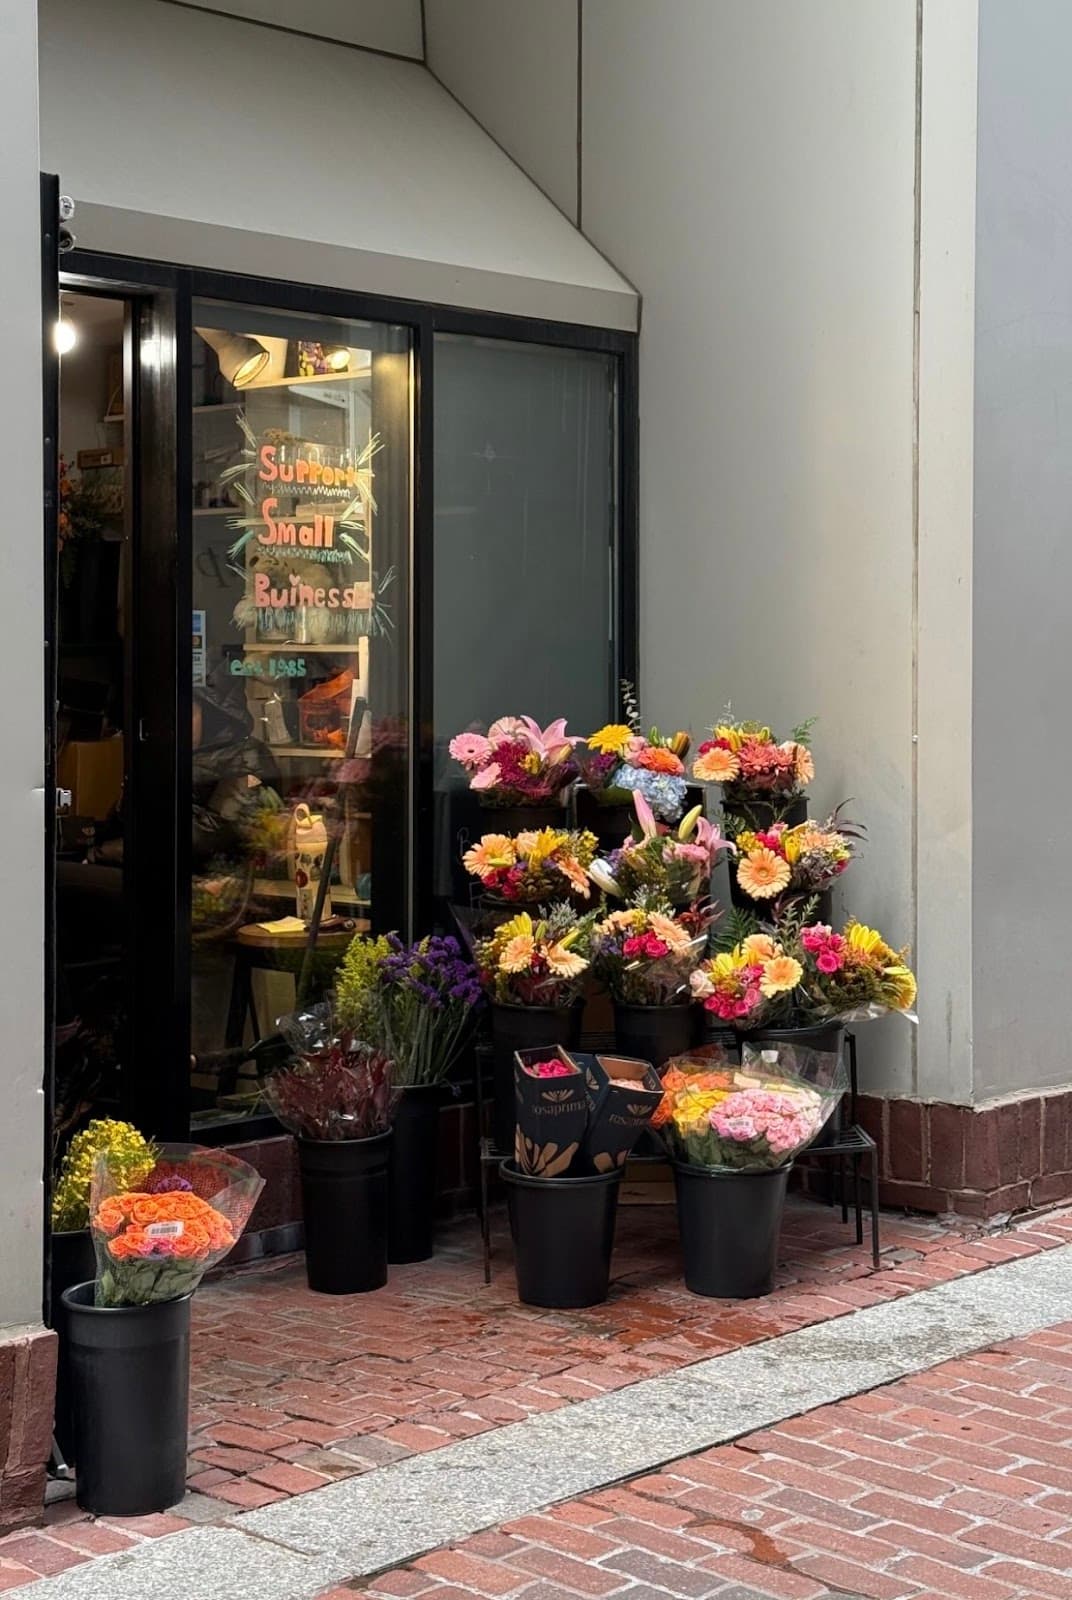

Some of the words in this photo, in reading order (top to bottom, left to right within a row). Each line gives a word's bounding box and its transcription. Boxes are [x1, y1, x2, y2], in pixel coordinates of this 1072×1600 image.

[258, 445, 357, 486] Support
[258, 498, 334, 547] Small
[269, 657, 307, 677] 1985
